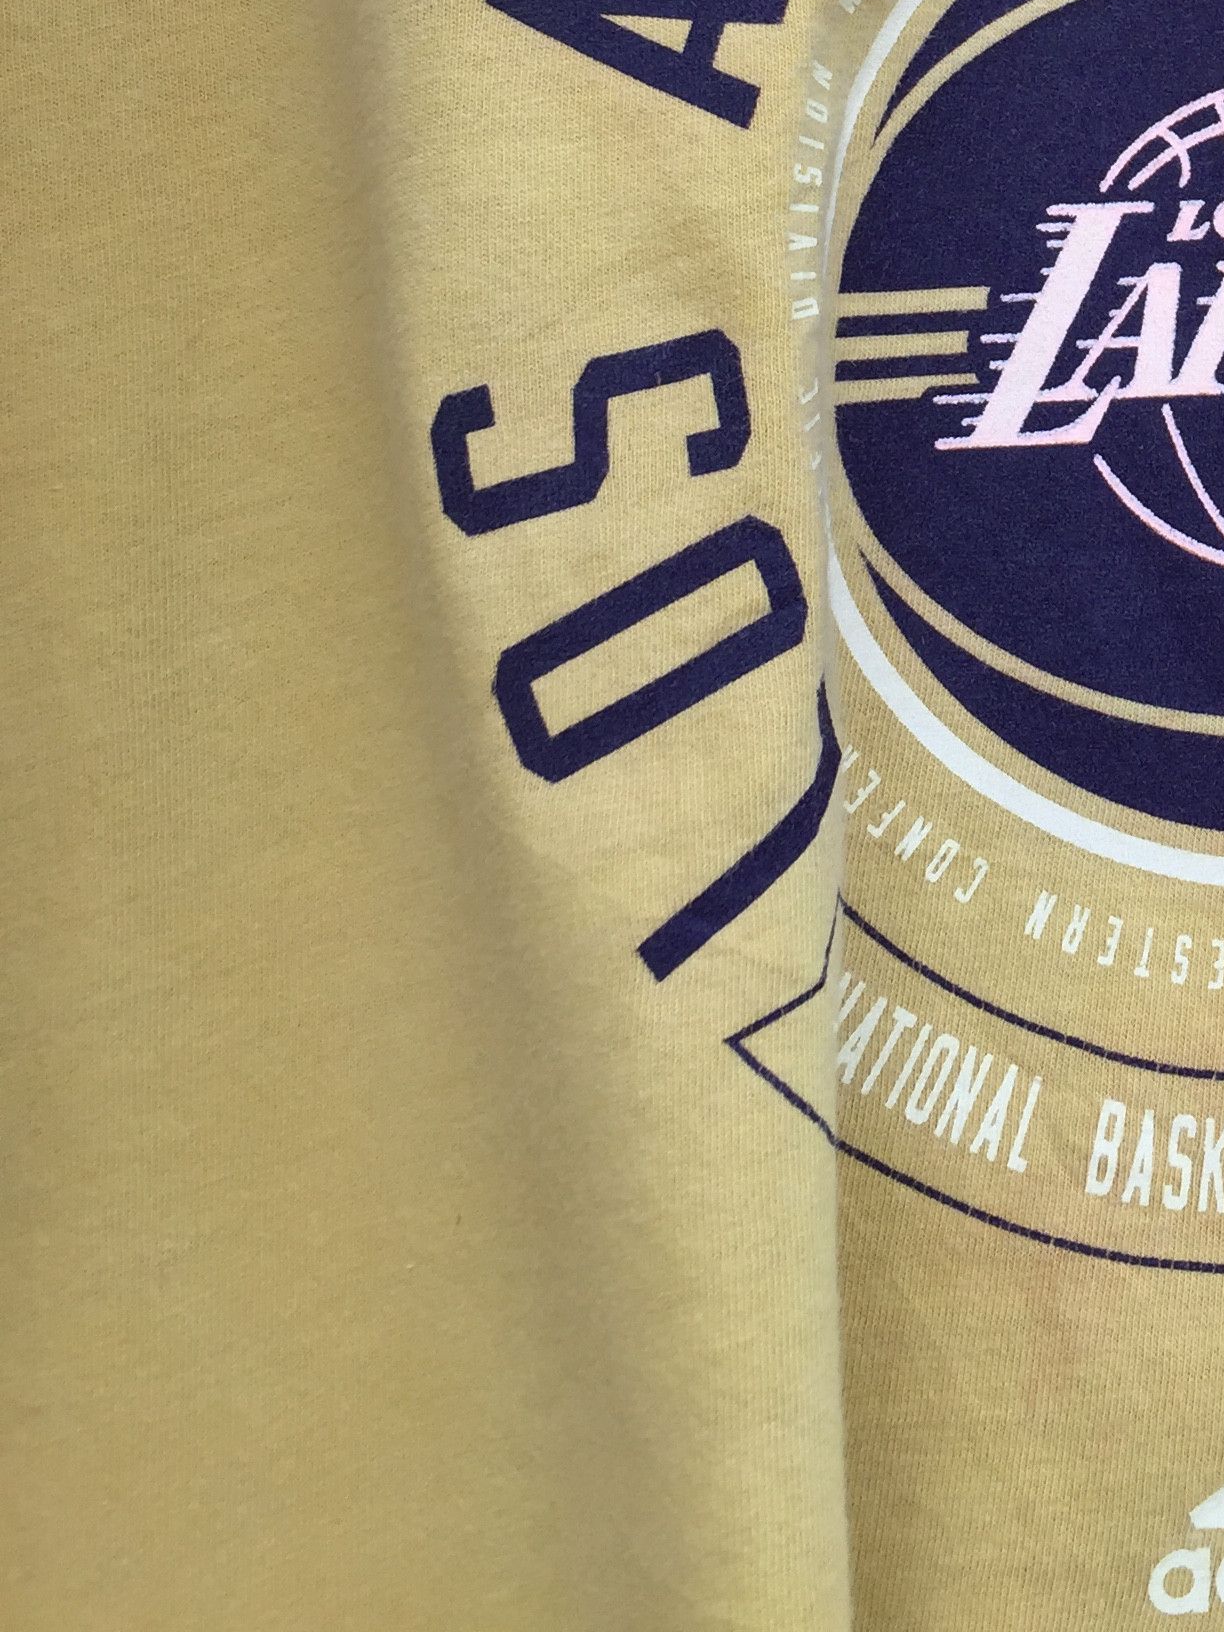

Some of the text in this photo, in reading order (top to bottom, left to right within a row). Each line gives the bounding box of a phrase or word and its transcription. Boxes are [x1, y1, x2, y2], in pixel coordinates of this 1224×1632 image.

[789, 59, 834, 321] DIVISION
[431, 328, 842, 982] LOS
[834, 971, 1043, 1174] NATIONAL
